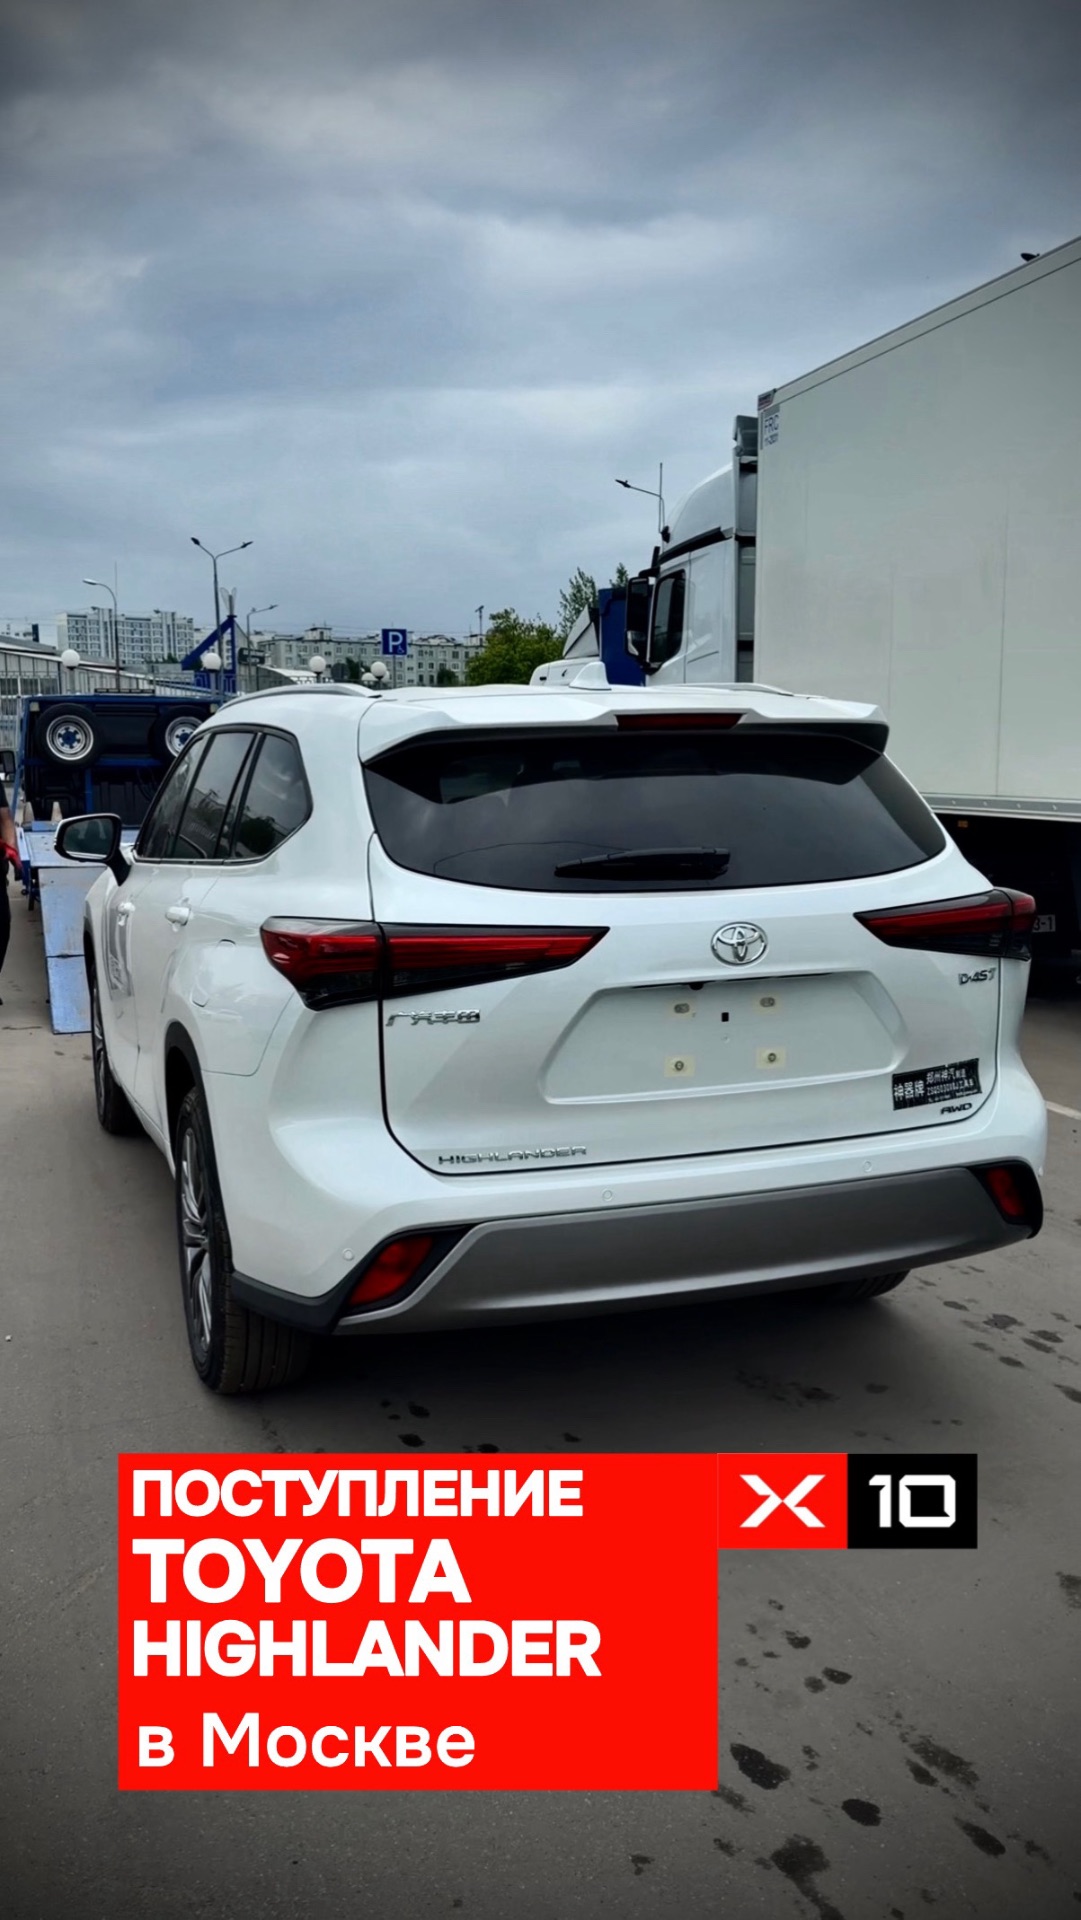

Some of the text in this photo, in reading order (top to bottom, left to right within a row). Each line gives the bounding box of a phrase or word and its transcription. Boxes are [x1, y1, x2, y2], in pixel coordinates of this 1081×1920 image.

[388, 631, 403, 653] P
[940, 1101, 973, 1115] AWD
[438, 1145, 587, 1165] HIGHLANDER
